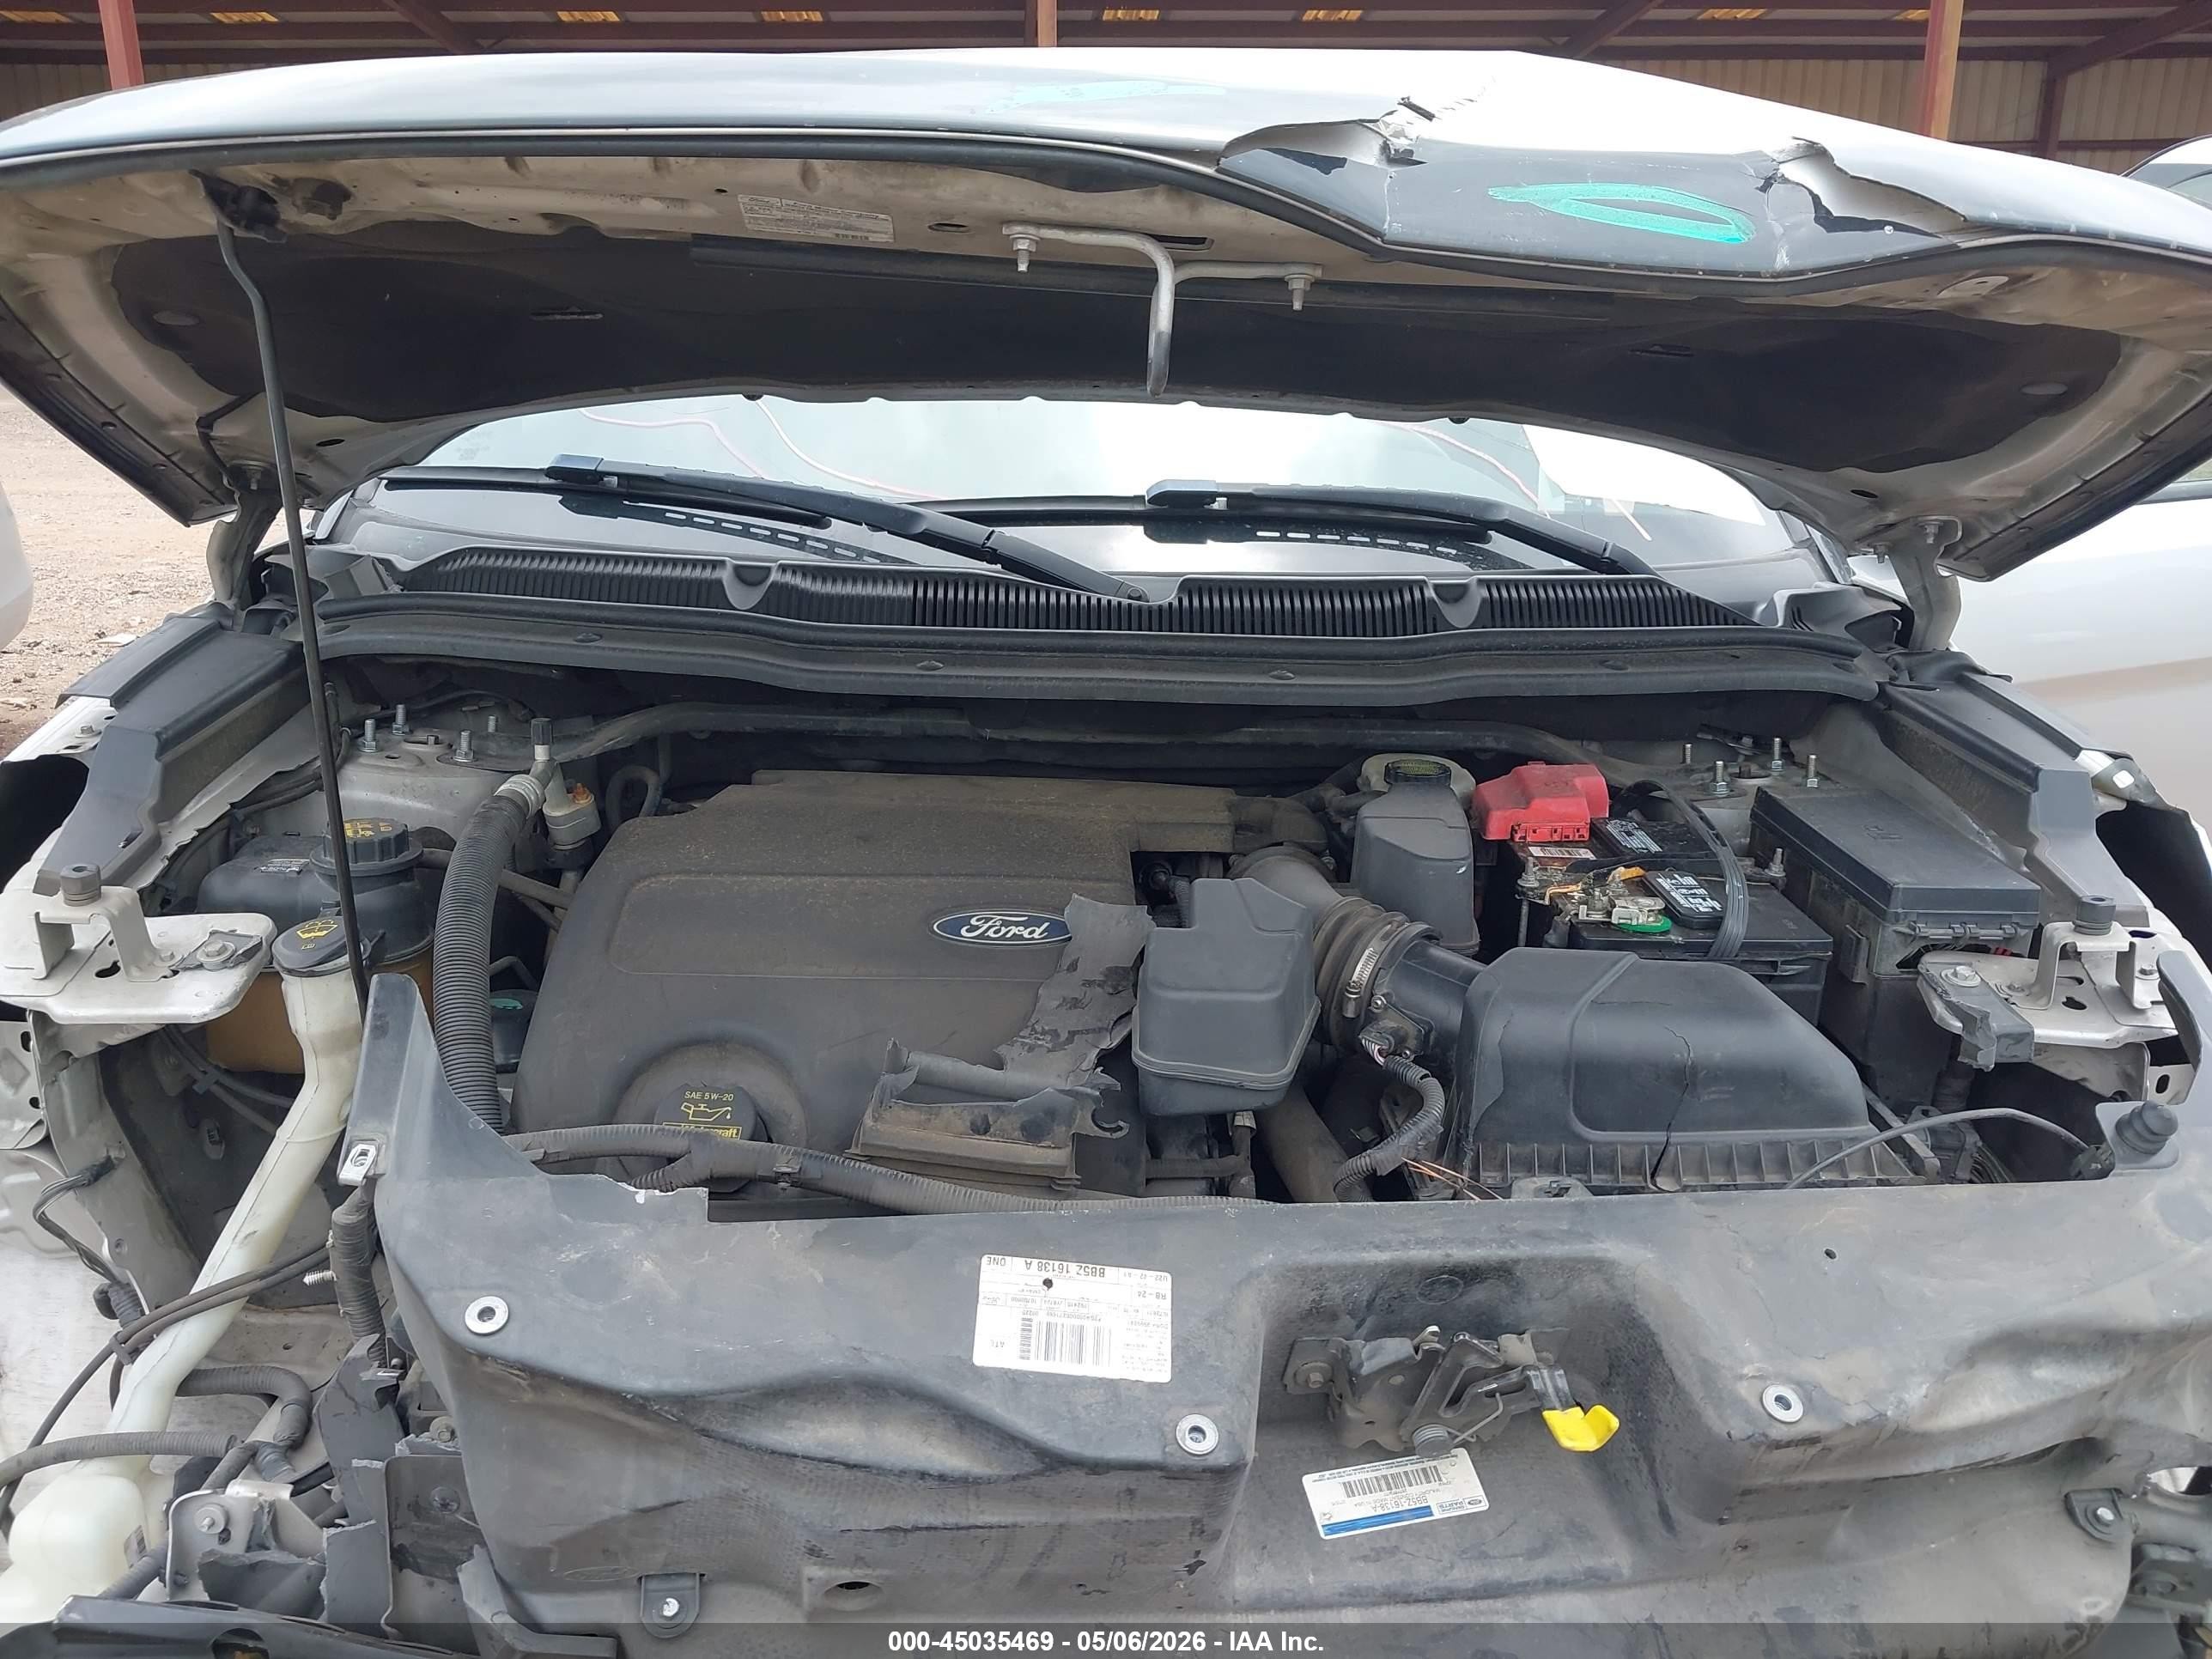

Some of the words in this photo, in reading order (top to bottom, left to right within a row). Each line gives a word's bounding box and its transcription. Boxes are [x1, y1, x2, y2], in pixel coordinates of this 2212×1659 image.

[961, 915, 1050, 939] Ford
[684, 1091, 702, 1099] SAE
[986, 1256, 1007, 1267] ONE
[1024, 1260, 1033, 1271] A
[1037, 1261, 1072, 1275] 16138
[1075, 1265, 1106, 1279] BB5Z
[1373, 1496, 1429, 1513] BB5Z-16138-A
